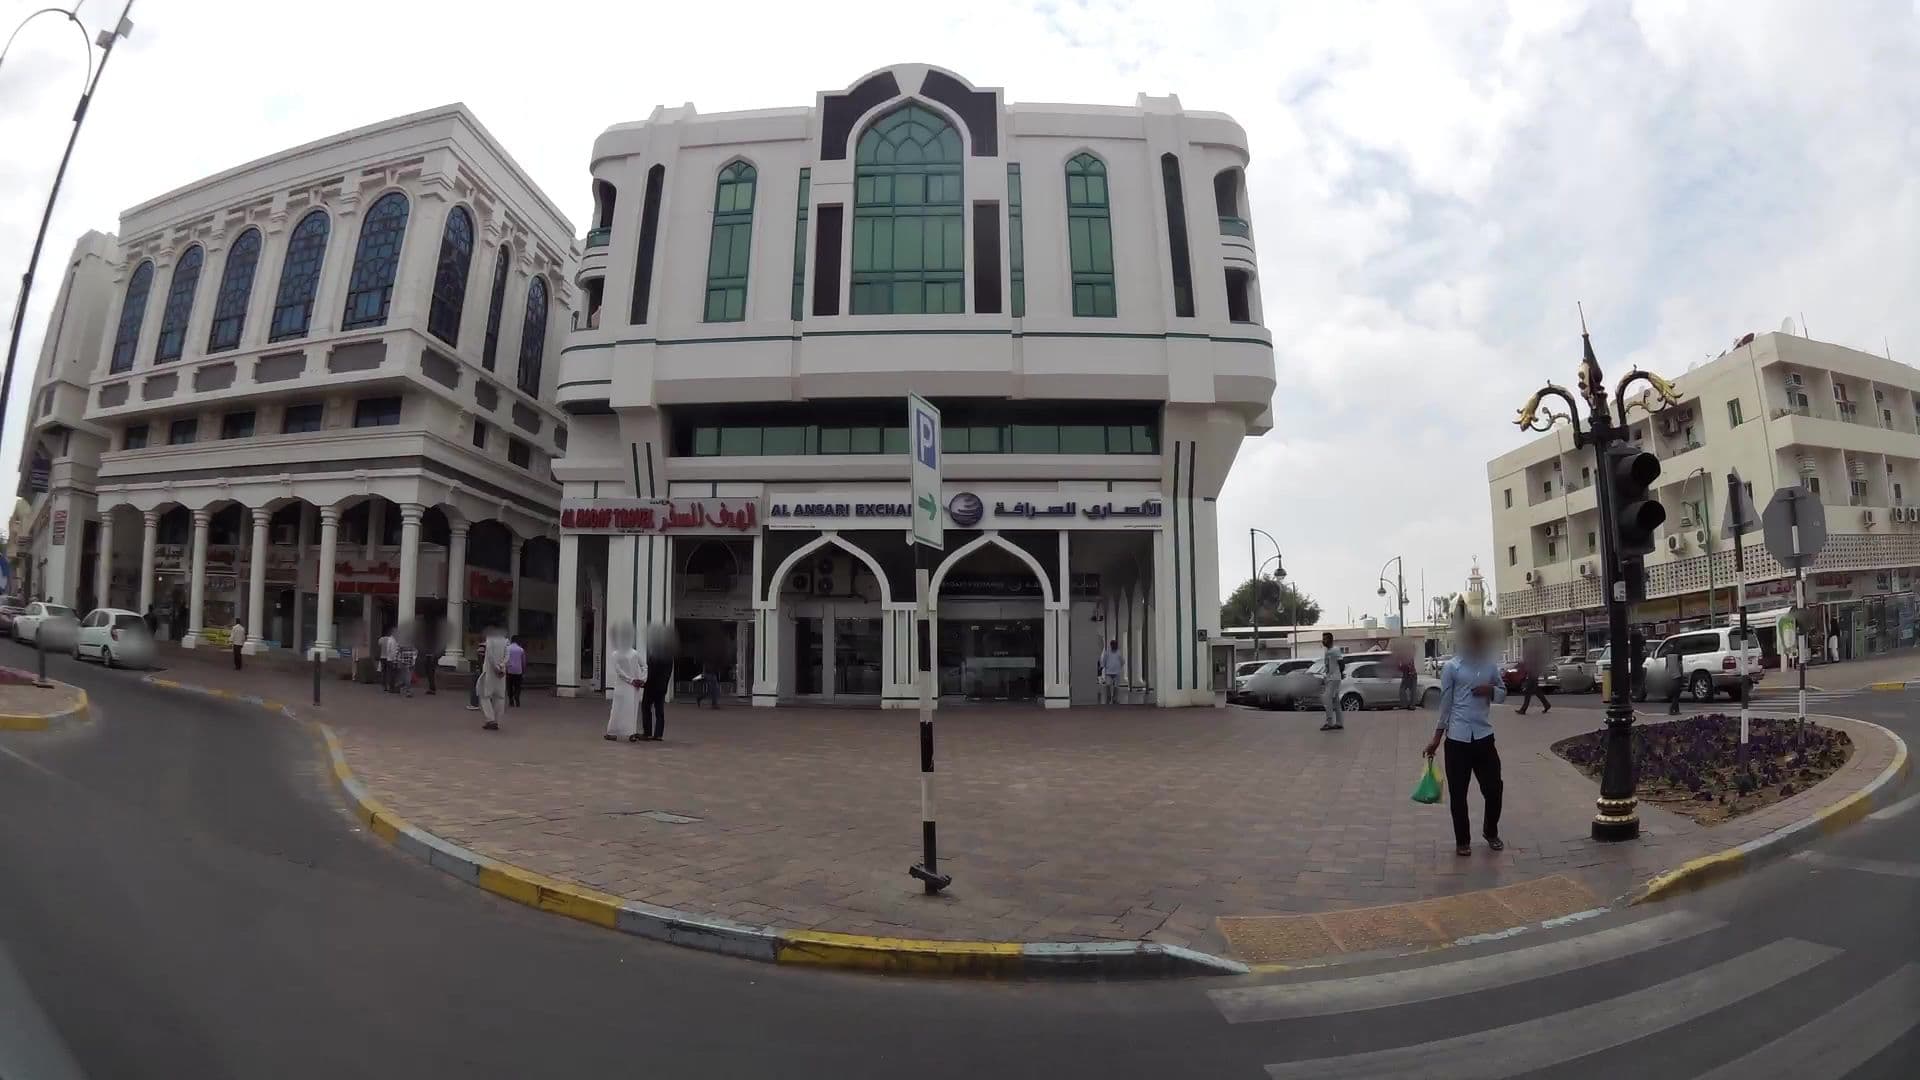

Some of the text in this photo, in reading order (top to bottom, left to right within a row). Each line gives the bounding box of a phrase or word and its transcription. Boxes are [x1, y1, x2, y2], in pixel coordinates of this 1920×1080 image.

[919, 413, 934, 462] P
[771, 504, 791, 517] AL
[794, 504, 850, 517] ANSARI
[994, 502, 1077, 519] للصرافة
